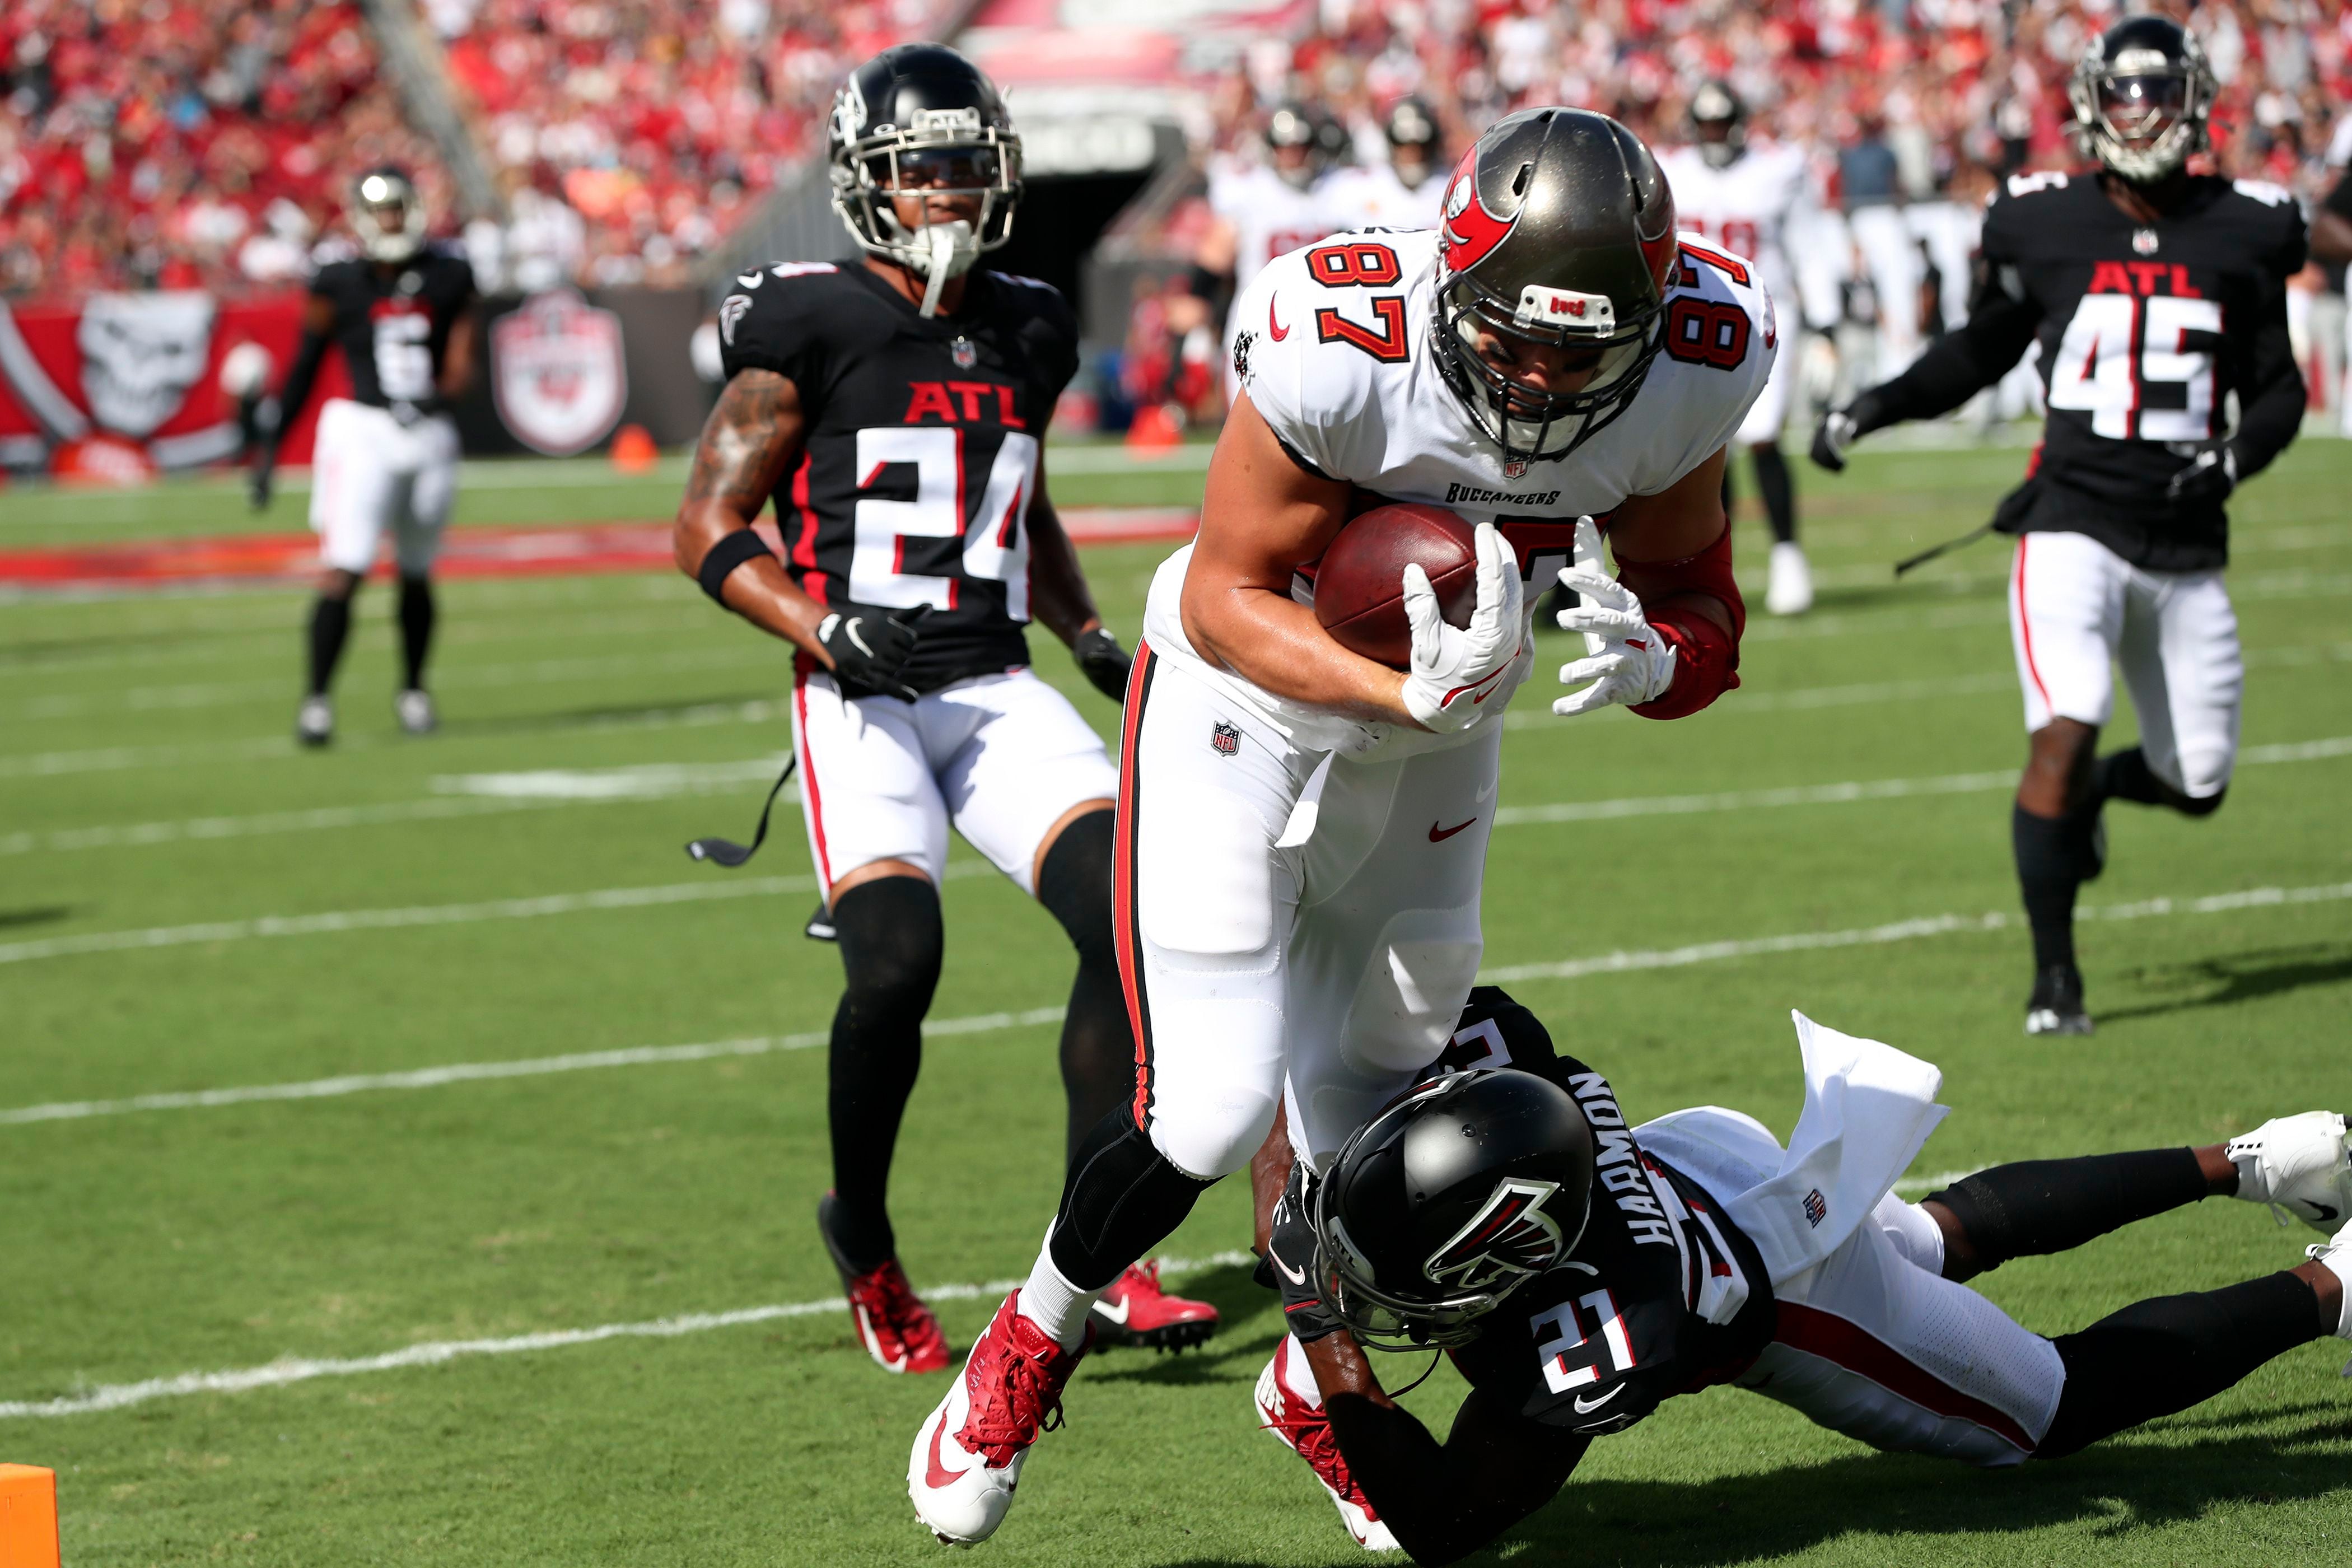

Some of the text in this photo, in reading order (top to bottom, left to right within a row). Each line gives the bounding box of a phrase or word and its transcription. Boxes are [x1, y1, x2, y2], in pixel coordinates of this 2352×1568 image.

[1304, 242, 1411, 364] 87
[1663, 241, 1752, 372] 87
[2088, 260, 2202, 298] ATL
[903, 381, 1026, 430] ATL
[2048, 292, 2224, 441] 45
[1505, 461, 1526, 477] NFL
[847, 426, 1039, 623] 24
[1215, 733, 1234, 751] NFL
[1567, 1072, 1674, 1247] HARMON
[1332, 1233, 1356, 1268] ATL
[1529, 1287, 1637, 1394] 21
